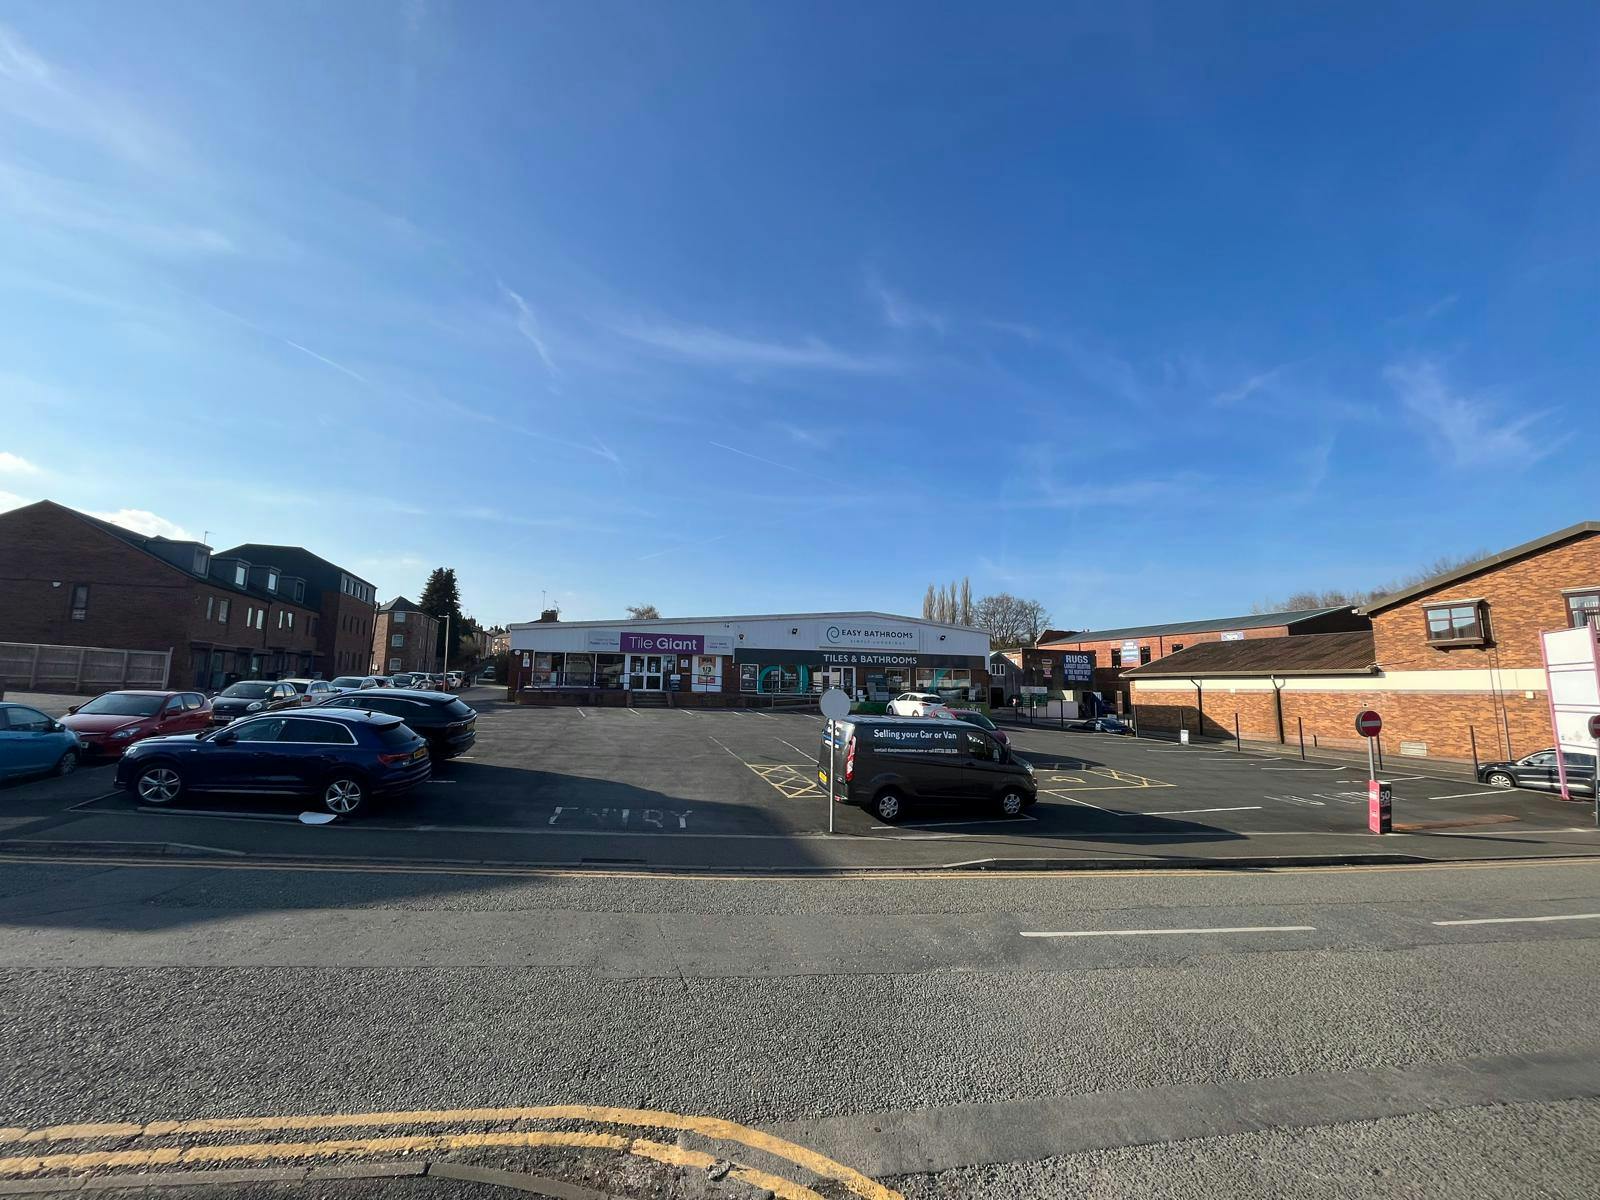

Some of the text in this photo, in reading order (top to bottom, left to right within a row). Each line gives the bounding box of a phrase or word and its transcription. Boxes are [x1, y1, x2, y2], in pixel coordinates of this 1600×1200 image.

[864, 630, 913, 639] BATHROOMS
[628, 636, 653, 649] Tile
[657, 637, 697, 650] Giant
[824, 654, 917, 665] TILES & BATHROOMS
[1065, 655, 1089, 663] RUGS
[873, 729, 900, 739] Selling
[901, 731, 918, 740] your
[920, 730, 932, 738] Car
[943, 731, 956, 739] Van
[1380, 790, 1390, 801] 50
